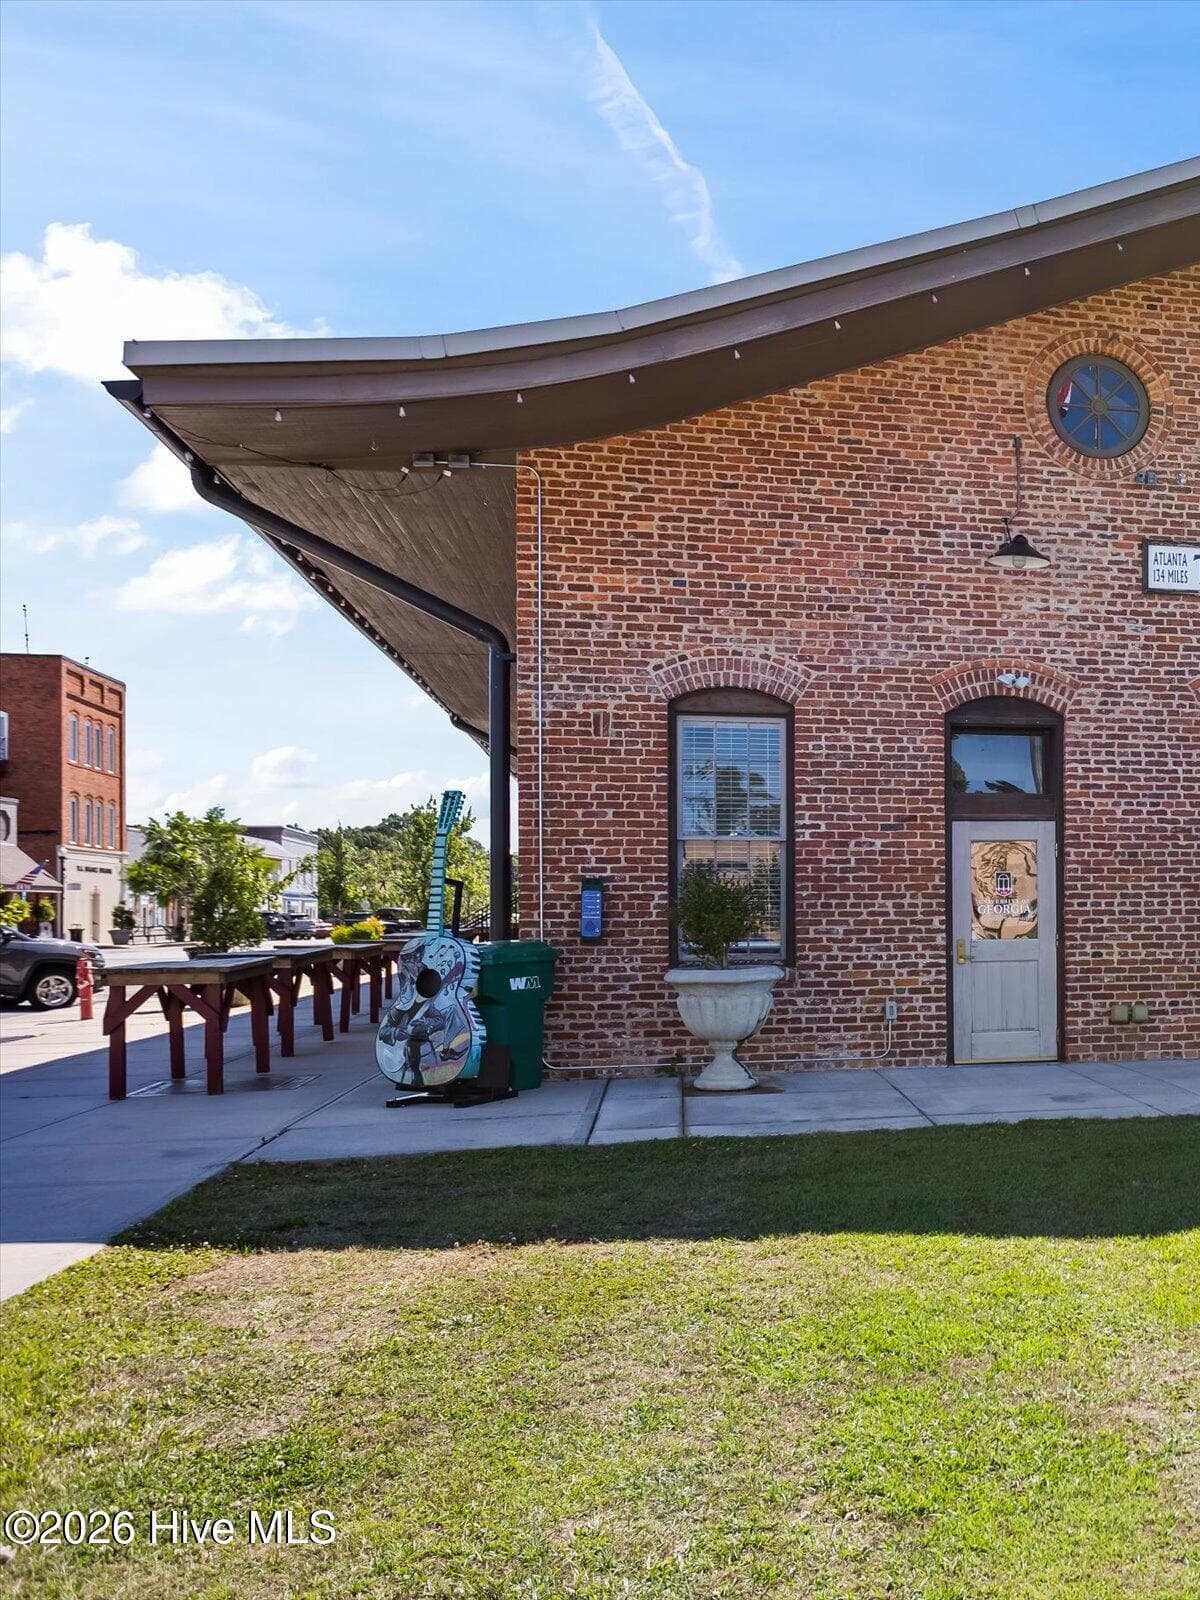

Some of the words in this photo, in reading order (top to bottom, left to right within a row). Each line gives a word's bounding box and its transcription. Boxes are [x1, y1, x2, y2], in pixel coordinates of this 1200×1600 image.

[1153, 551, 1188, 566] ATLANTA
[1153, 569, 1165, 582] 134
[1167, 569, 1189, 584] MILES
[977, 904, 1031, 914] GEORGIA
